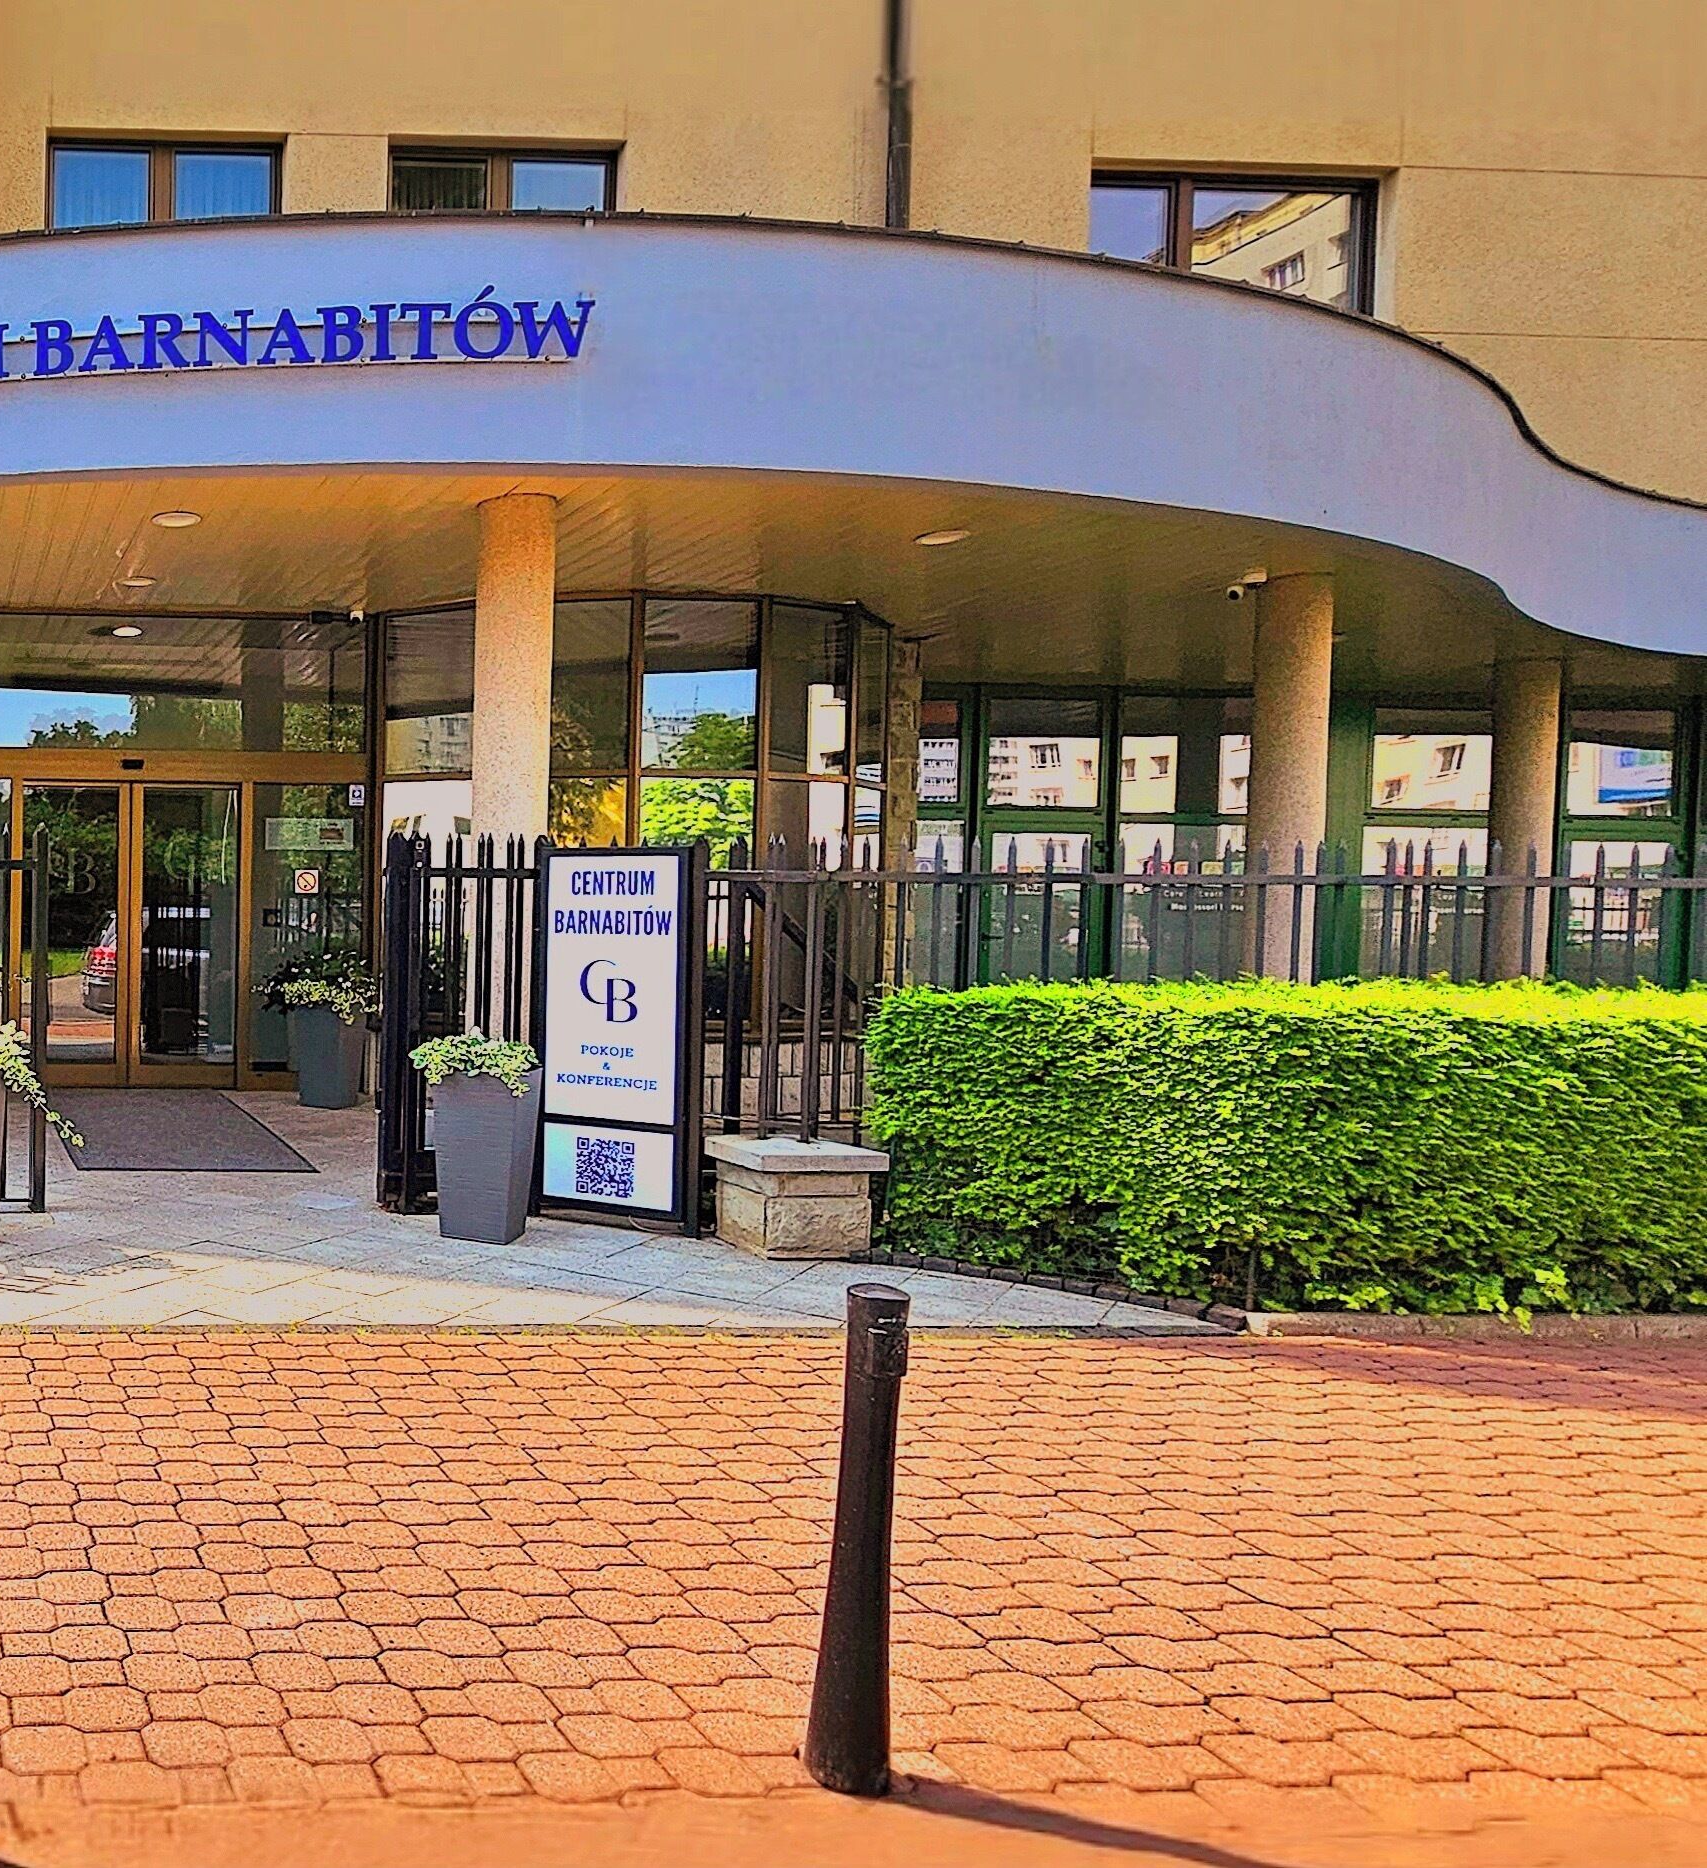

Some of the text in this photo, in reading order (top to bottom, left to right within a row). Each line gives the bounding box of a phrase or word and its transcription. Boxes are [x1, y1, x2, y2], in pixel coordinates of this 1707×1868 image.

[30, 285, 596, 376] BARNABITÓW
[571, 870, 655, 896] CENTRUM
[554, 905, 672, 936] BARNABITÓW
[580, 1044, 634, 1058] POKOJE
[602, 1061, 611, 1071] &
[556, 1073, 658, 1091] KONFERENCJE
